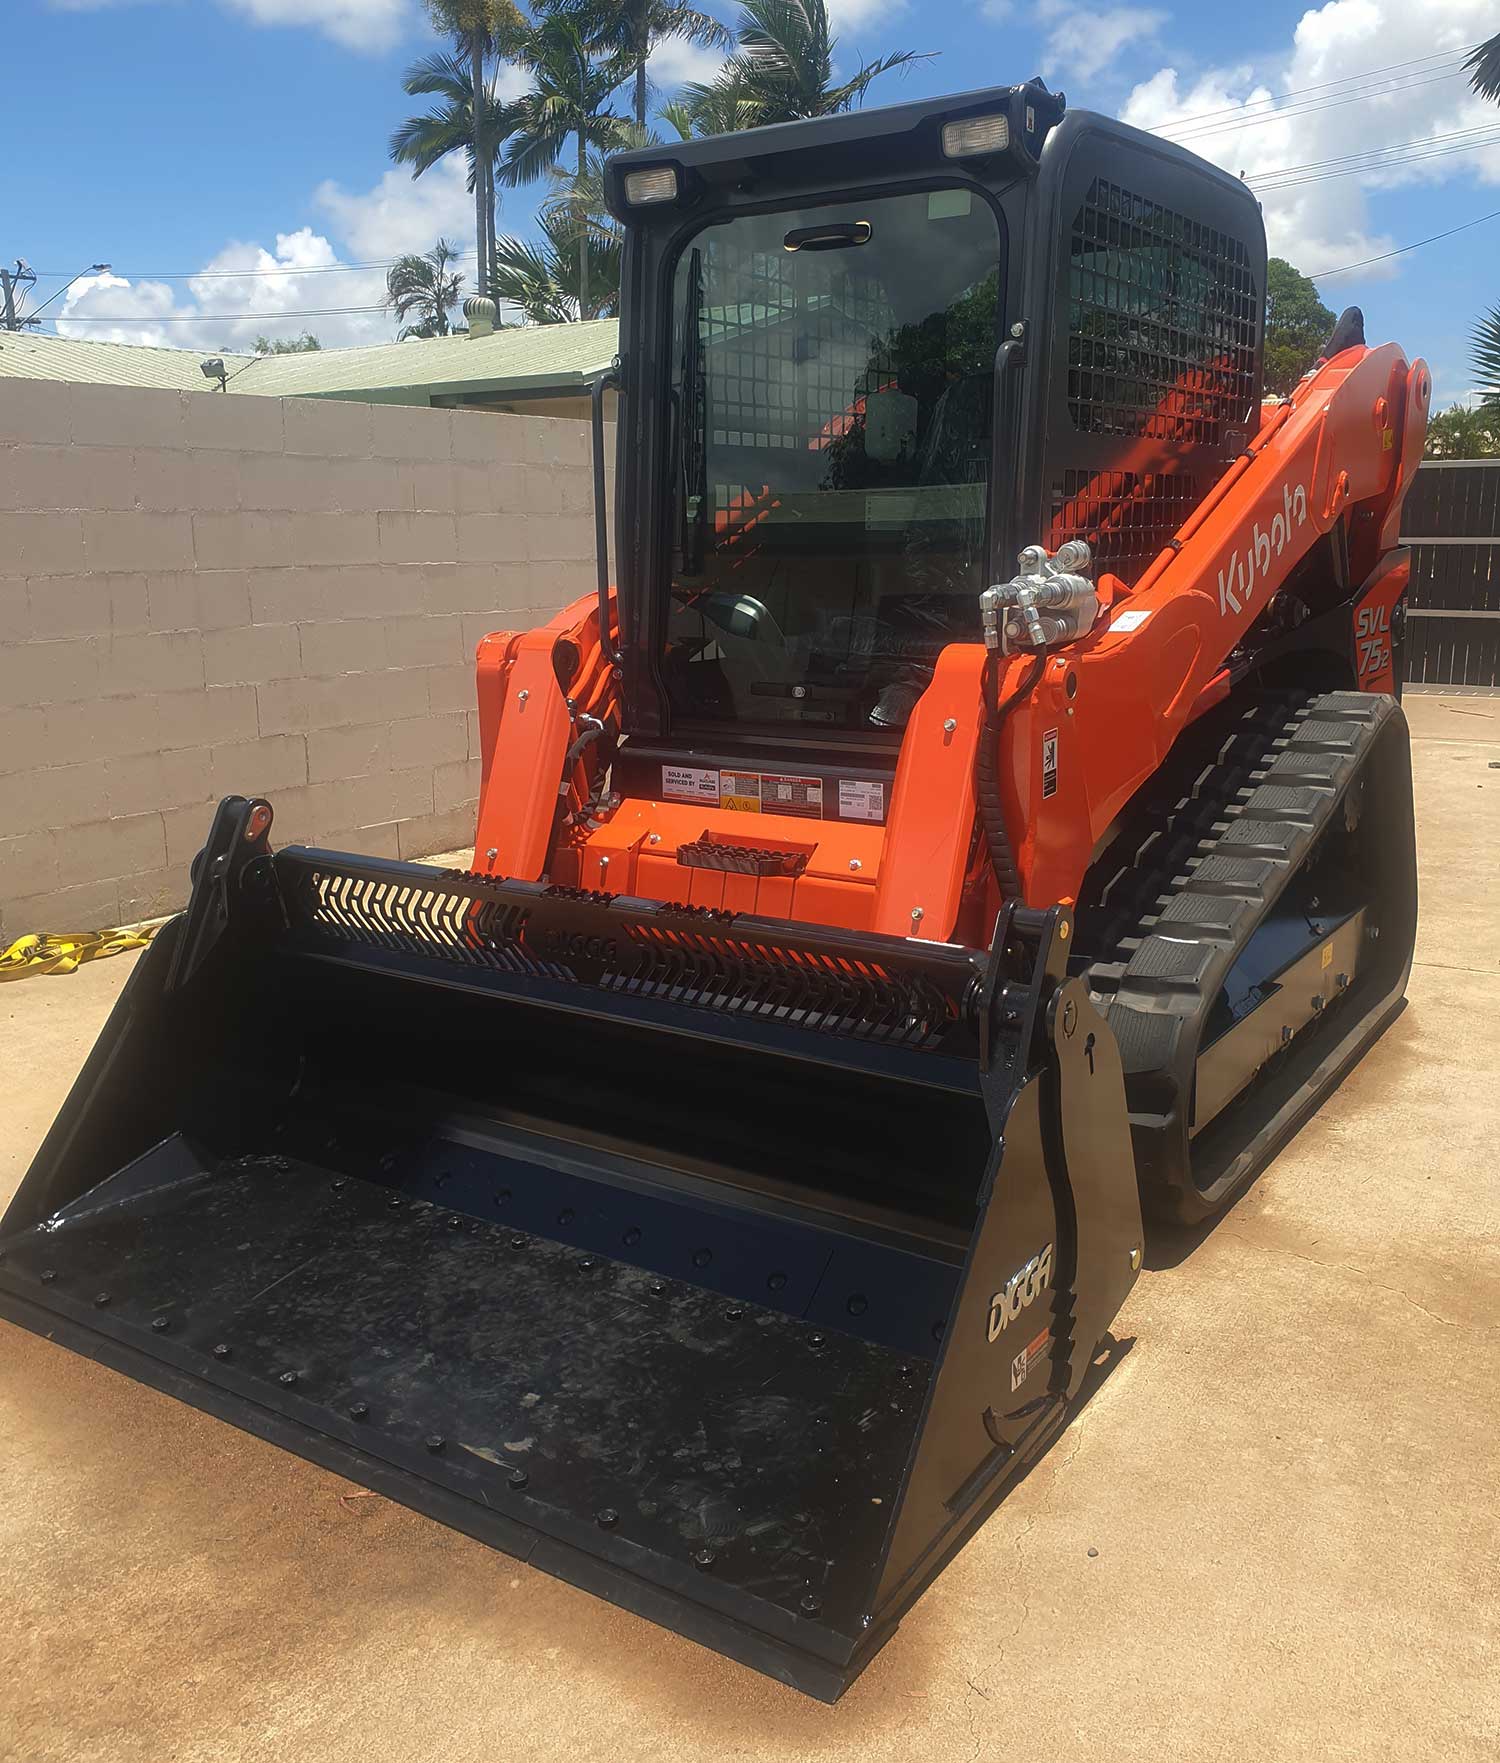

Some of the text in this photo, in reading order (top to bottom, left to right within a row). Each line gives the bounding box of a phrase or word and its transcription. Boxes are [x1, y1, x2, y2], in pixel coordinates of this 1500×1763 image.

[1218, 483, 1306, 616] Kubota
[1356, 606, 1389, 638] SVL
[666, 778, 688, 786] SERVICED
[987, 1243, 1053, 1343] DIGGA
